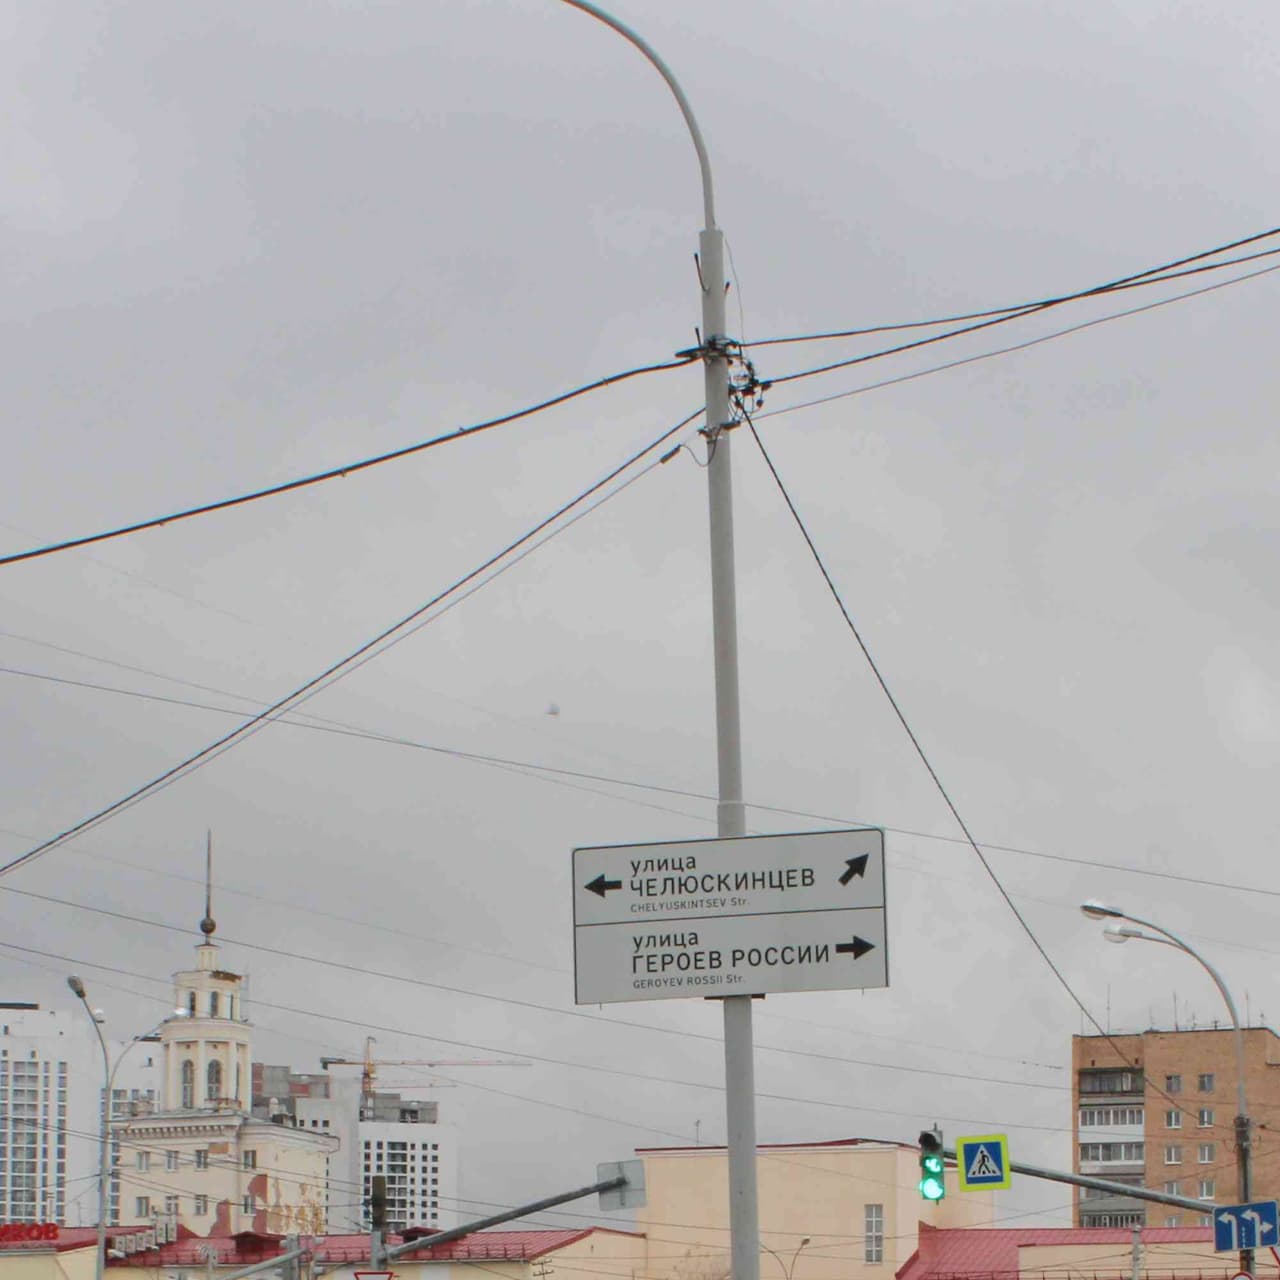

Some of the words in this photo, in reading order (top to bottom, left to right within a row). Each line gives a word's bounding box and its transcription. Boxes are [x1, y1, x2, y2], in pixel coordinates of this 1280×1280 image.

[630, 856, 697, 878] улица
[630, 868, 815, 897] ЧЕЛЮСКИНЦЕВ
[630, 897, 727, 913] CHELYUSKINTSEV
[730, 897, 751, 907] Str.
[632, 932, 699, 954] улица
[632, 950, 723, 975] ГЕРОЕВ
[731, 944, 830, 969] РОССИИ
[632, 976, 684, 990] GEROYEV
[686, 974, 723, 986] ROSSII
[726, 973, 746, 985] Str.
